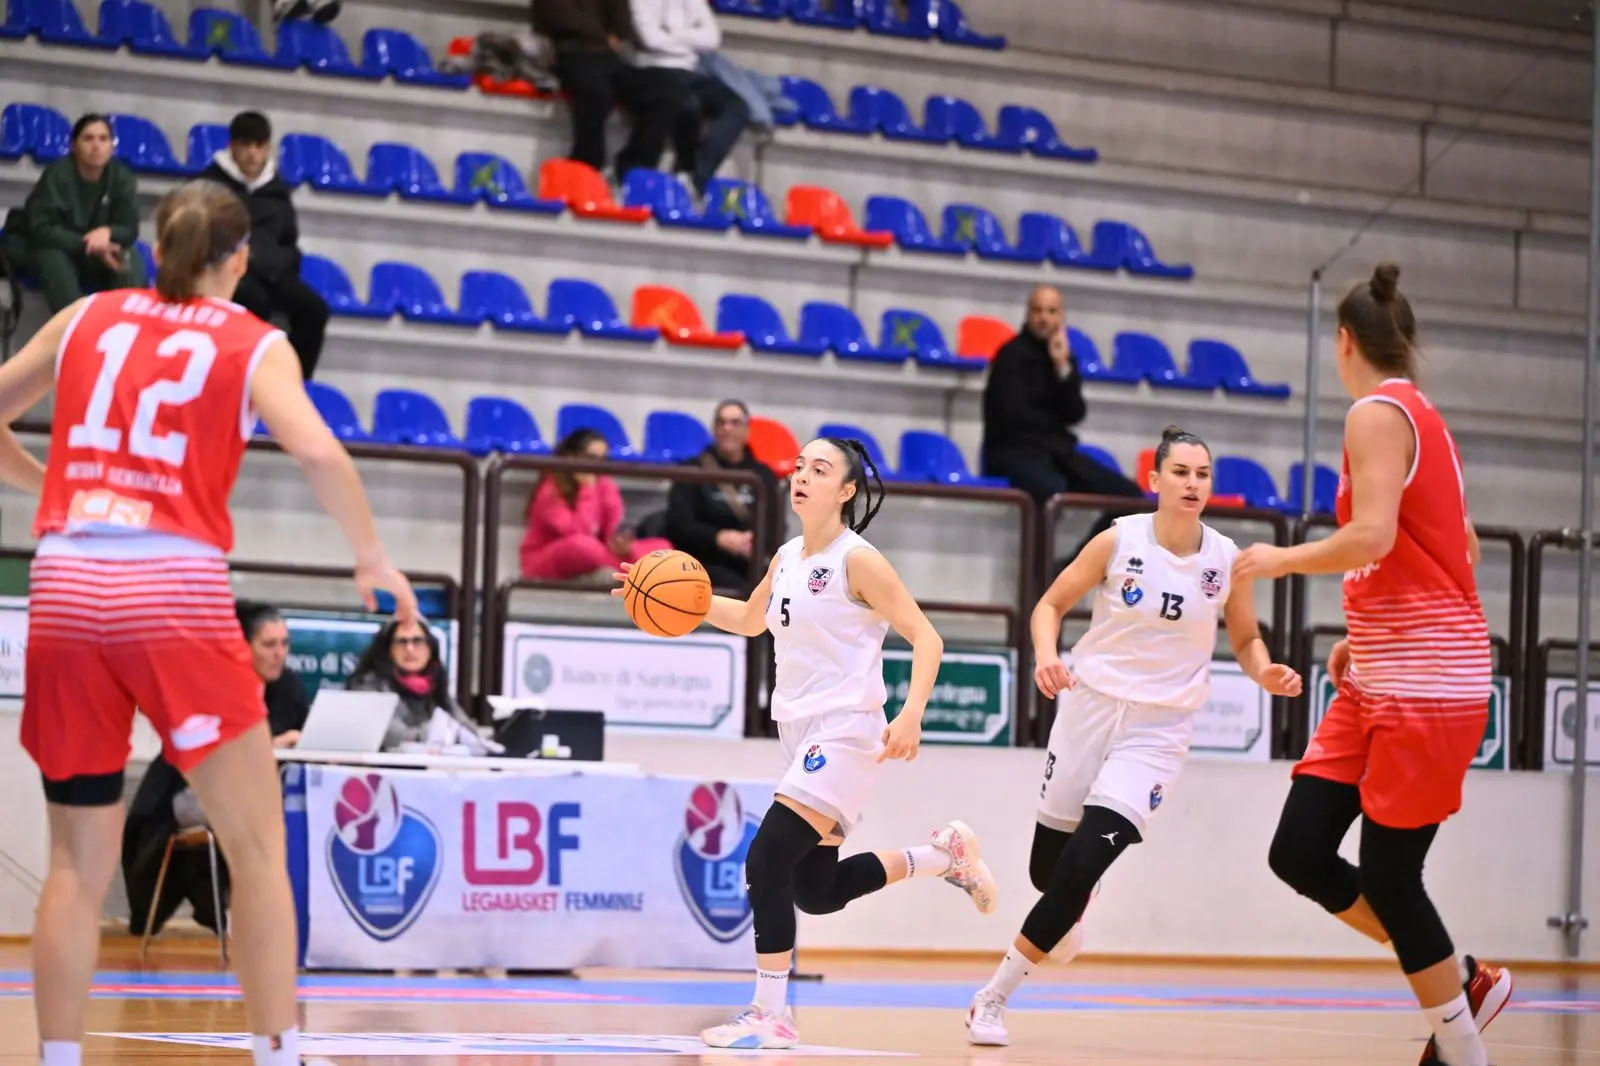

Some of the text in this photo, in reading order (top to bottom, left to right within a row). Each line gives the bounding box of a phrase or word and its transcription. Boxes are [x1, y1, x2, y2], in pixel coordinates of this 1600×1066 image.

[67, 321, 218, 468] 12
[780, 597, 791, 627] 5
[1159, 591, 1185, 621] 13
[321, 651, 339, 675] di
[462, 800, 581, 887] LBF
[358, 856, 414, 895] LBF
[462, 891, 645, 912] LEGABASKET FEMMINILE
